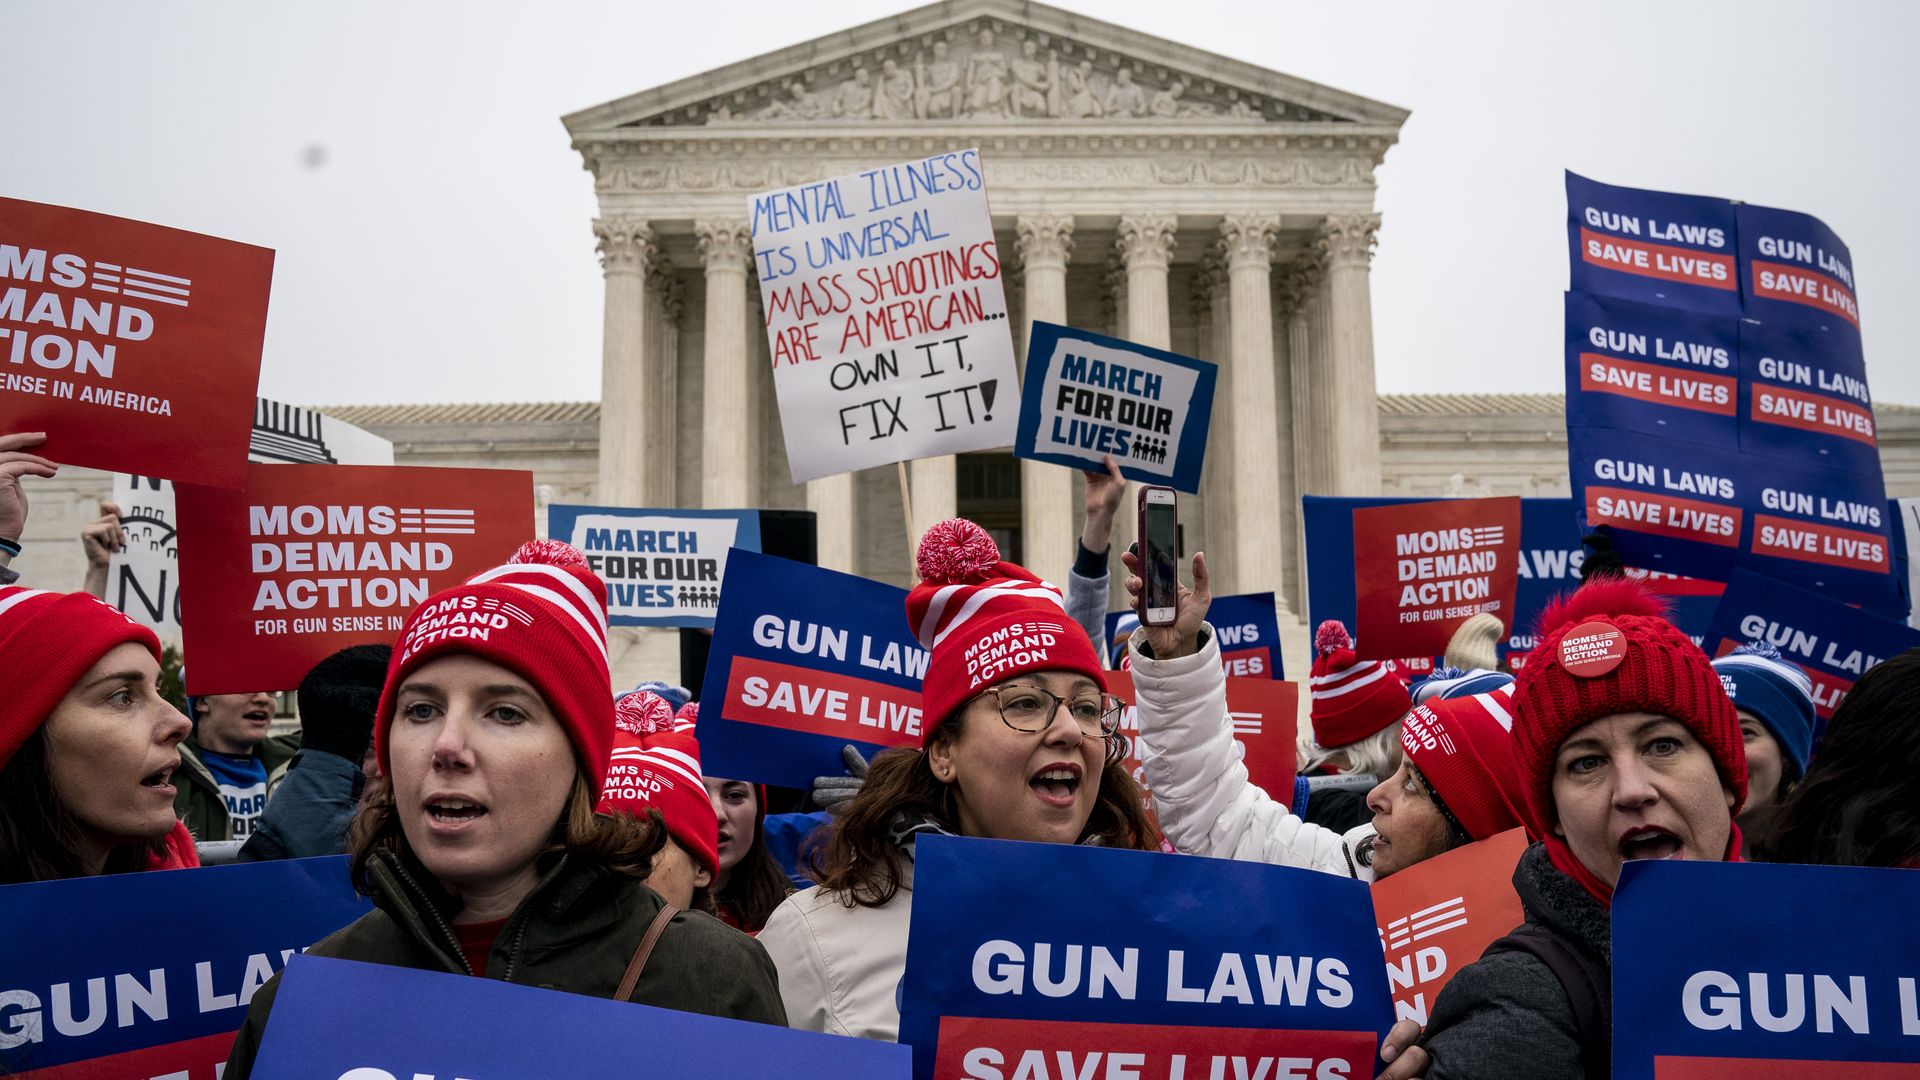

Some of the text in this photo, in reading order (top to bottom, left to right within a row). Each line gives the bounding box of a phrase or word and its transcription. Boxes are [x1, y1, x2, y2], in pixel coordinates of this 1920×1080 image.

[751, 151, 982, 238] MENTAL ILLNESS
[756, 208, 950, 281] IS UNIVERSAL
[1585, 207, 1725, 249] GUN LAWS
[0, 244, 87, 288] MS
[1587, 239, 1728, 281] SAVE LIVES
[1758, 236, 1853, 289] GUN LAW
[767, 241, 1000, 327] MASS SHOOTINGS
[1760, 271, 1818, 299] SAVE
[0, 287, 154, 341] MAND
[773, 286, 1005, 369] ARE AMERICAN...
[0, 328, 117, 379] ION
[830, 335, 973, 391] OWN IT,
[1589, 327, 1730, 369] GUN LAWS
[1060, 353, 1162, 401] MARCH
[1590, 363, 1729, 405] SAVE LIVES
[1759, 357, 1868, 404] GUN LAWS
[52, 380, 74, 399] IN
[79, 385, 172, 416] AMERICA
[839, 379, 998, 445] FIX IT!
[1056, 384, 1173, 435] FOR OUR
[1759, 394, 1873, 437] SAVE LIVES
[1051, 415, 1132, 457] LIVES
[1594, 458, 1735, 499] GUN LAWS
[249, 504, 397, 536] MOMS
[1596, 497, 1734, 537] SAVE LIVES
[1761, 488, 1881, 528] GUN LAWS
[251, 541, 454, 574] DEMAND
[585, 527, 698, 554] MARCH
[1396, 527, 1474, 556] MOMS
[1760, 526, 1883, 563] SAVE LIVES
[586, 555, 718, 581] FOR OUR
[1398, 550, 1497, 582] DEMAND
[1517, 550, 1584, 579] AWS
[118, 564, 182, 626] N
[252, 577, 429, 612] ACTION
[605, 583, 675, 608] IVES
[1399, 576, 1489, 608] ACTION
[255, 616, 403, 636] FOR GUN SENSE IN
[404, 611, 509, 647] DEMAND
[1400, 611, 1420, 623] FOR
[1422, 609, 1443, 621] GUN
[1446, 605, 1474, 619] SENSE
[400, 625, 489, 665] ACTION
[753, 614, 932, 681] GUN LAW
[964, 623, 1024, 661] MOMS
[967, 633, 1056, 675] DEMAND
[1217, 623, 1260, 646] WS
[1562, 634, 1598, 647] MOMS
[1563, 640, 1613, 655] DEMAND
[1740, 614, 1885, 675] GUN LA
[970, 649, 1048, 689] ACTION
[1400, 657, 1430, 670] VES
[1564, 648, 1608, 662] ACTION
[741, 676, 923, 737] SAVE LIVE
[1415, 704, 1437, 726] OMS
[1401, 726, 1421, 755] TION
[604, 776, 661, 792] MAND
[607, 765, 638, 775] MS
[223, 793, 266, 815] MAR
[602, 788, 650, 801] TION
[971, 939, 1139, 1000] GUN
[1166, 949, 1354, 1009] LAWS
[0, 946, 311, 1050] GUN LA
[1681, 970, 1870, 1035] GUN
